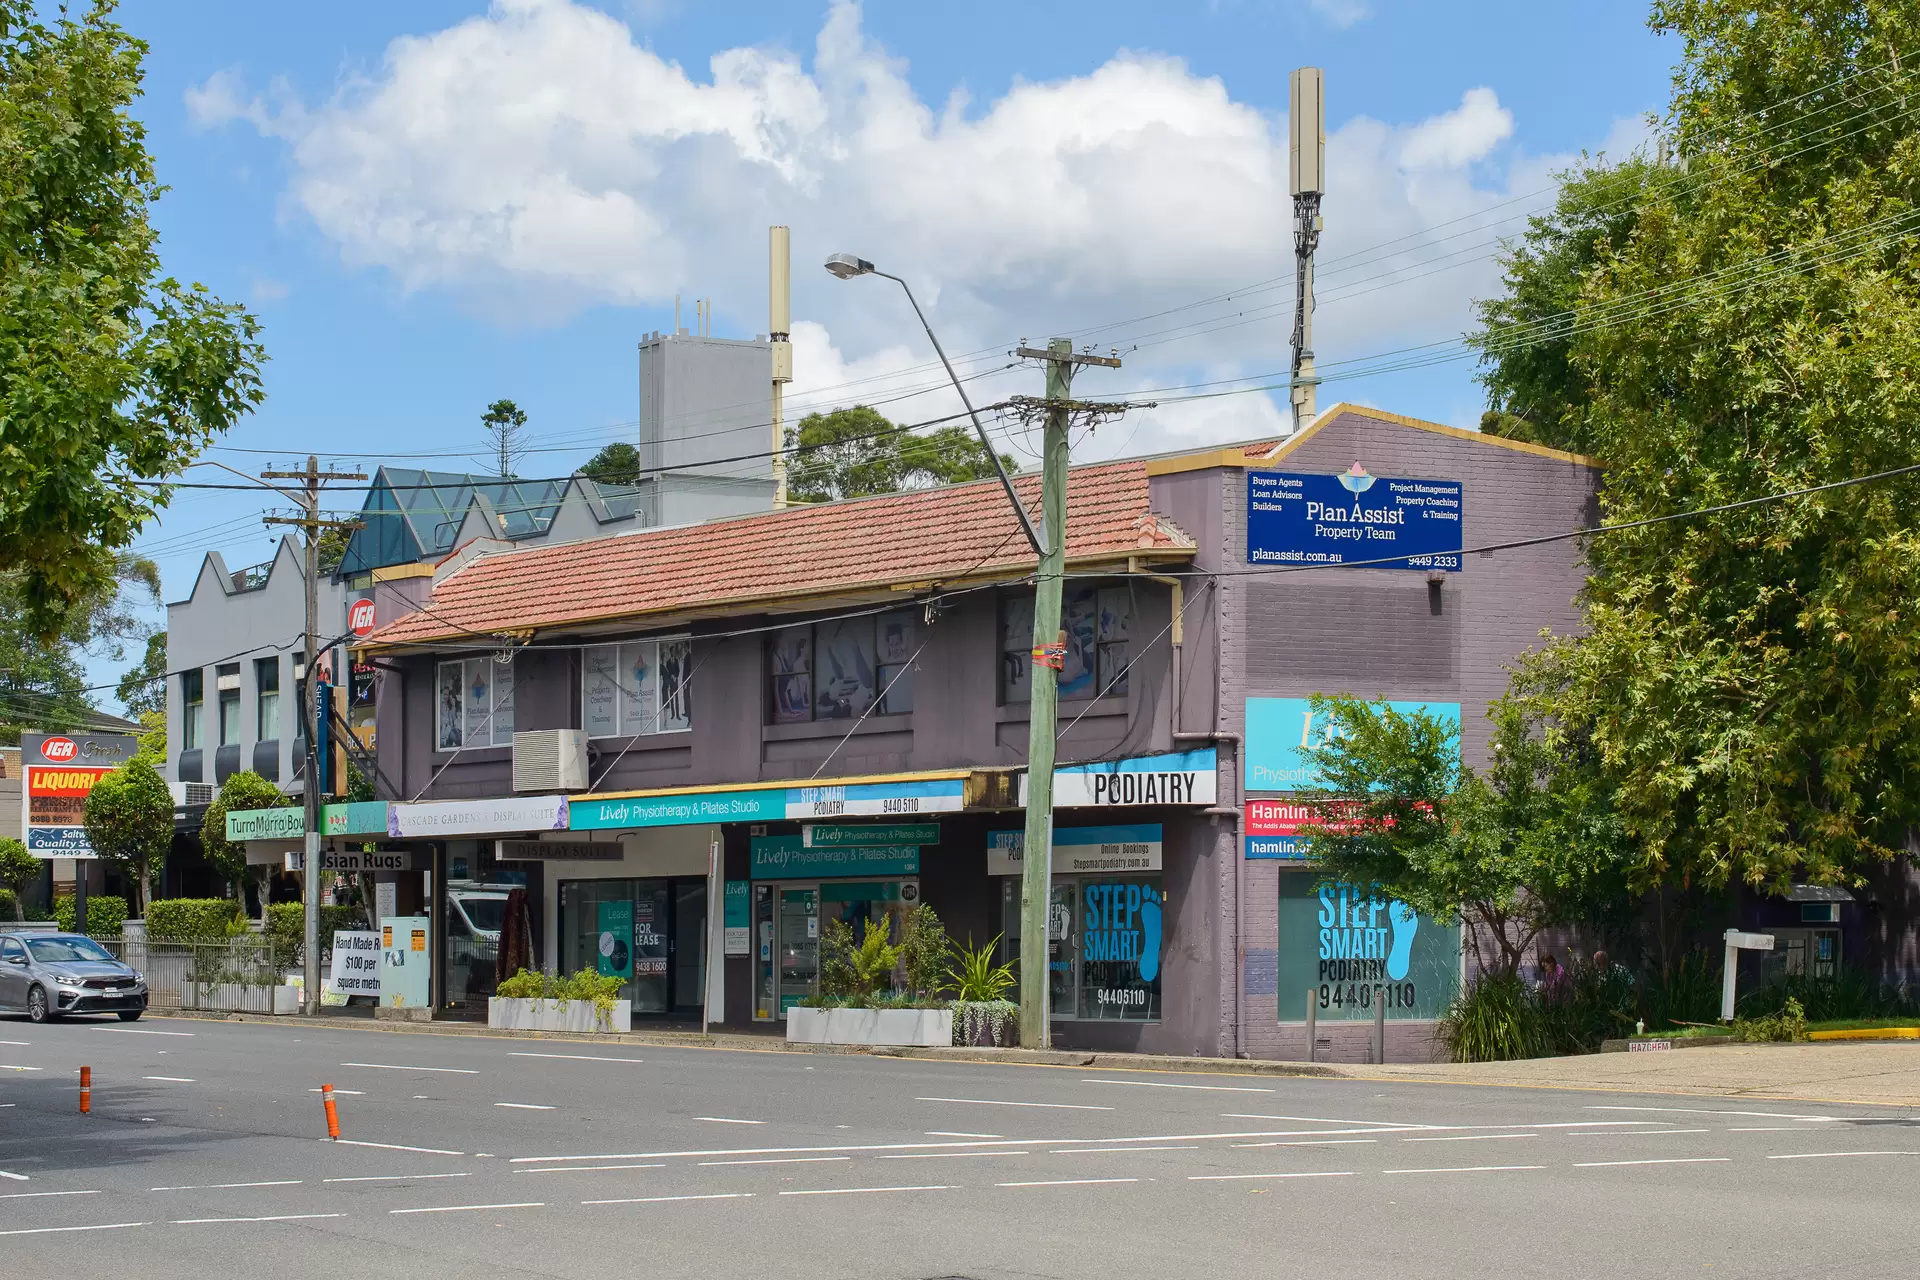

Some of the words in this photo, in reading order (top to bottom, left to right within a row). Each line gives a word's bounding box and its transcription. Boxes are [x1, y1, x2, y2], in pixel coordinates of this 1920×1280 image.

[1252, 476, 1277, 488] Buyers
[1279, 478, 1303, 489] Agents
[1389, 482, 1413, 494] Project
[1415, 484, 1459, 496] Management
[1252, 489, 1270, 499] Loan
[1272, 489, 1303, 500] Advisors
[1396, 496, 1425, 508] Property
[1426, 497, 1459, 508] Coaching
[1252, 502, 1282, 512] Builders
[1306, 502, 1347, 522] Plan
[1350, 502, 1405, 525] Assist
[1423, 510, 1429, 519] &
[1430, 510, 1459, 521] Training
[1315, 525, 1363, 541] Property
[1365, 526, 1396, 541] Team
[1252, 547, 1342, 564] planassist.com.au
[1408, 556, 1432, 567] 9449
[1433, 556, 1458, 568] 2333
[352, 605, 374, 629] IGA
[45, 741, 75, 757] IGA
[81, 740, 124, 758] Fresh
[801, 788, 820, 804] STEP
[821, 786, 847, 802] SMART
[1095, 773, 1196, 804] PODIATRY
[31, 797, 85, 807] PERSIA
[814, 800, 845, 816] PODIATRY
[883, 800, 902, 814] 9440
[903, 798, 919, 812] 5110
[600, 804, 630, 823] Lively
[633, 804, 691, 821] Physiotherapy
[693, 803, 699, 815] &
[701, 801, 729, 814] Pilates
[731, 799, 760, 812] Studio
[1252, 804, 1309, 819] Hamlin
[230, 815, 286, 835] TurraMurra
[400, 813, 438, 828] CASCADE
[441, 811, 481, 825] GARDENS
[62, 830, 86, 840] Saltw
[815, 828, 843, 844] Lively
[844, 829, 888, 841] Physiotherapy
[889, 829, 895, 839] &
[895, 828, 915, 838] Pilates
[916, 826, 936, 837] Studio
[996, 833, 1014, 848] STEP
[36, 839, 77, 851] Quality
[517, 844, 568, 858] DISPLAY
[1101, 845, 1119, 855] Online
[1123, 843, 1150, 854] Bookings
[52, 850, 82, 858] 9449
[363, 853, 403, 870] Rugs
[756, 846, 791, 868] Lively
[792, 850, 849, 865] Physiotherapy
[851, 850, 858, 861] &
[859, 848, 887, 860] Pilates
[889, 845, 917, 859] Studio
[1073, 857, 1150, 870] Stepsmartpodiatry.com.au
[726, 883, 750, 897] Lively
[608, 907, 630, 920] Lease
[1086, 884, 1141, 929] STEP
[635, 923, 652, 935] FOR
[336, 936, 352, 950] Hand
[353, 937, 371, 951] Made
[635, 935, 660, 946] LEASE
[1084, 930, 1139, 961] SMART
[1319, 928, 1388, 960] SMART
[345, 956, 362, 970] $100
[364, 958, 377, 973] per
[636, 962, 652, 973] 9438
[652, 961, 668, 972] 1600
[1319, 960, 1387, 981] PODIATRY
[338, 977, 360, 991] square
[362, 977, 381, 990] metr
[1098, 988, 1146, 1005] 94405110
[1630, 1042, 1670, 1052] HAZCHEM
